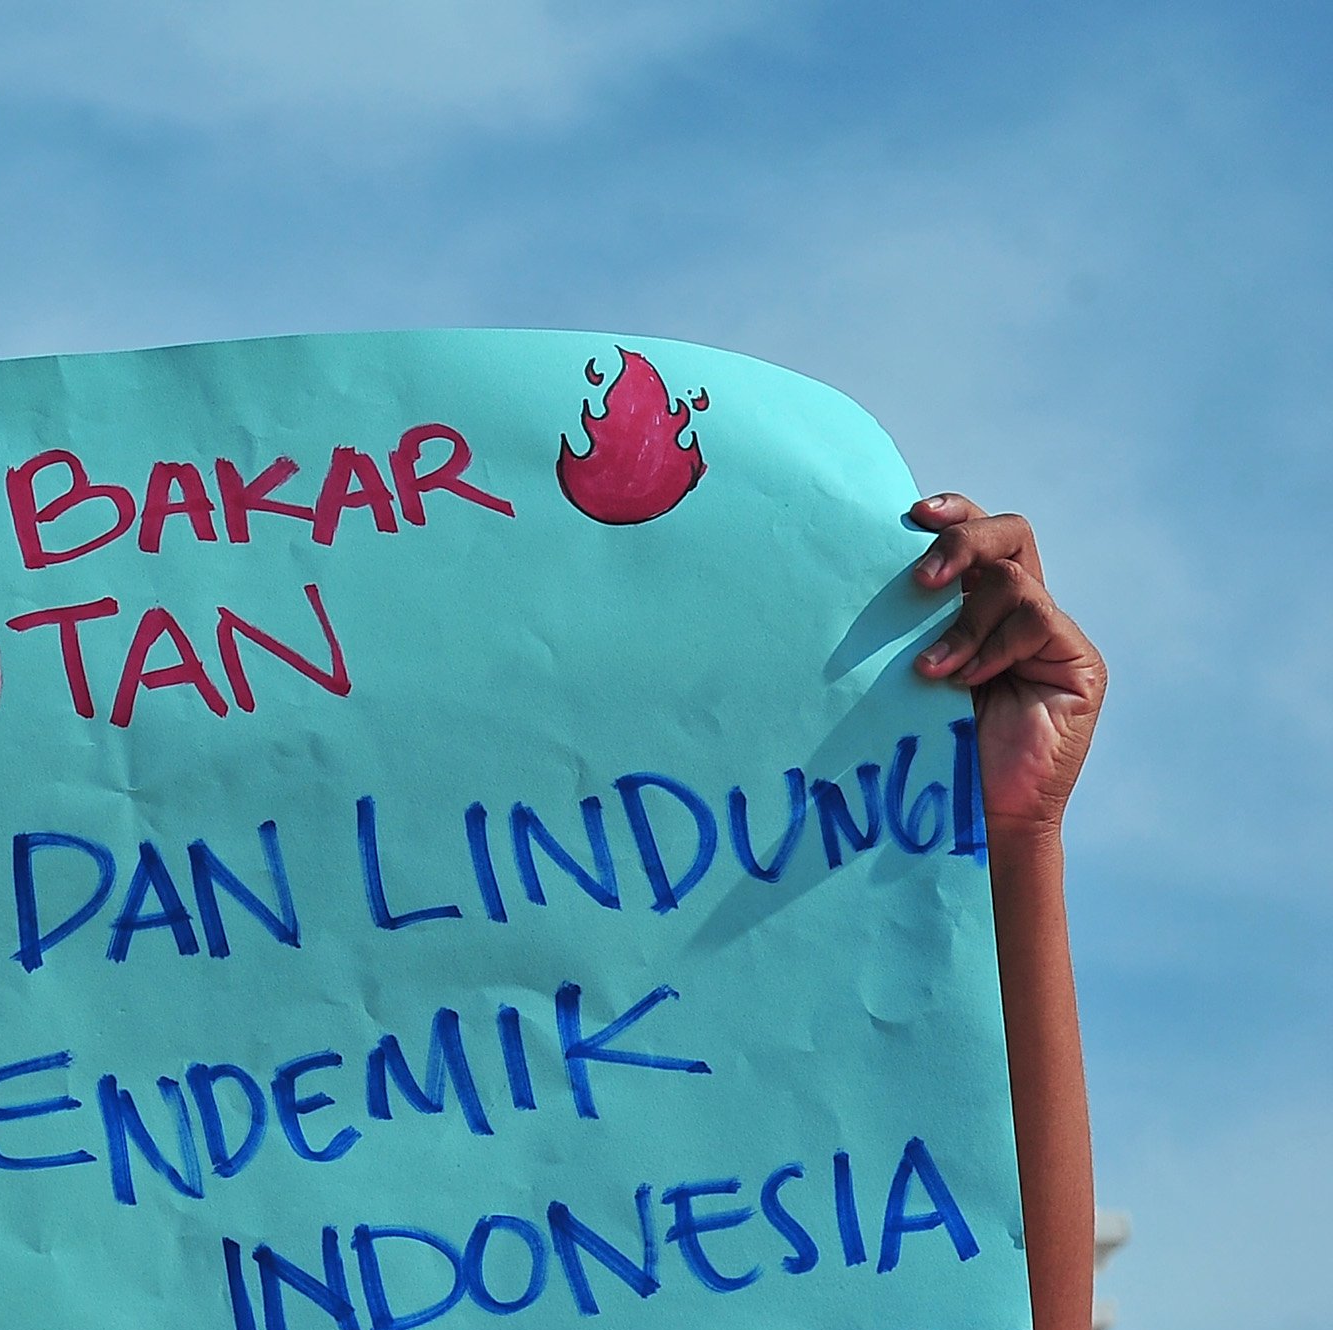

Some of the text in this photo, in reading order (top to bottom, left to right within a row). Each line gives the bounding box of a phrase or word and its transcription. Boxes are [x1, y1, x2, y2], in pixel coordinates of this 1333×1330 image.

[6, 423, 515, 570] BAKAR
[11, 820, 302, 974] DAN
[356, 716, 989, 915] LINDUNGI
